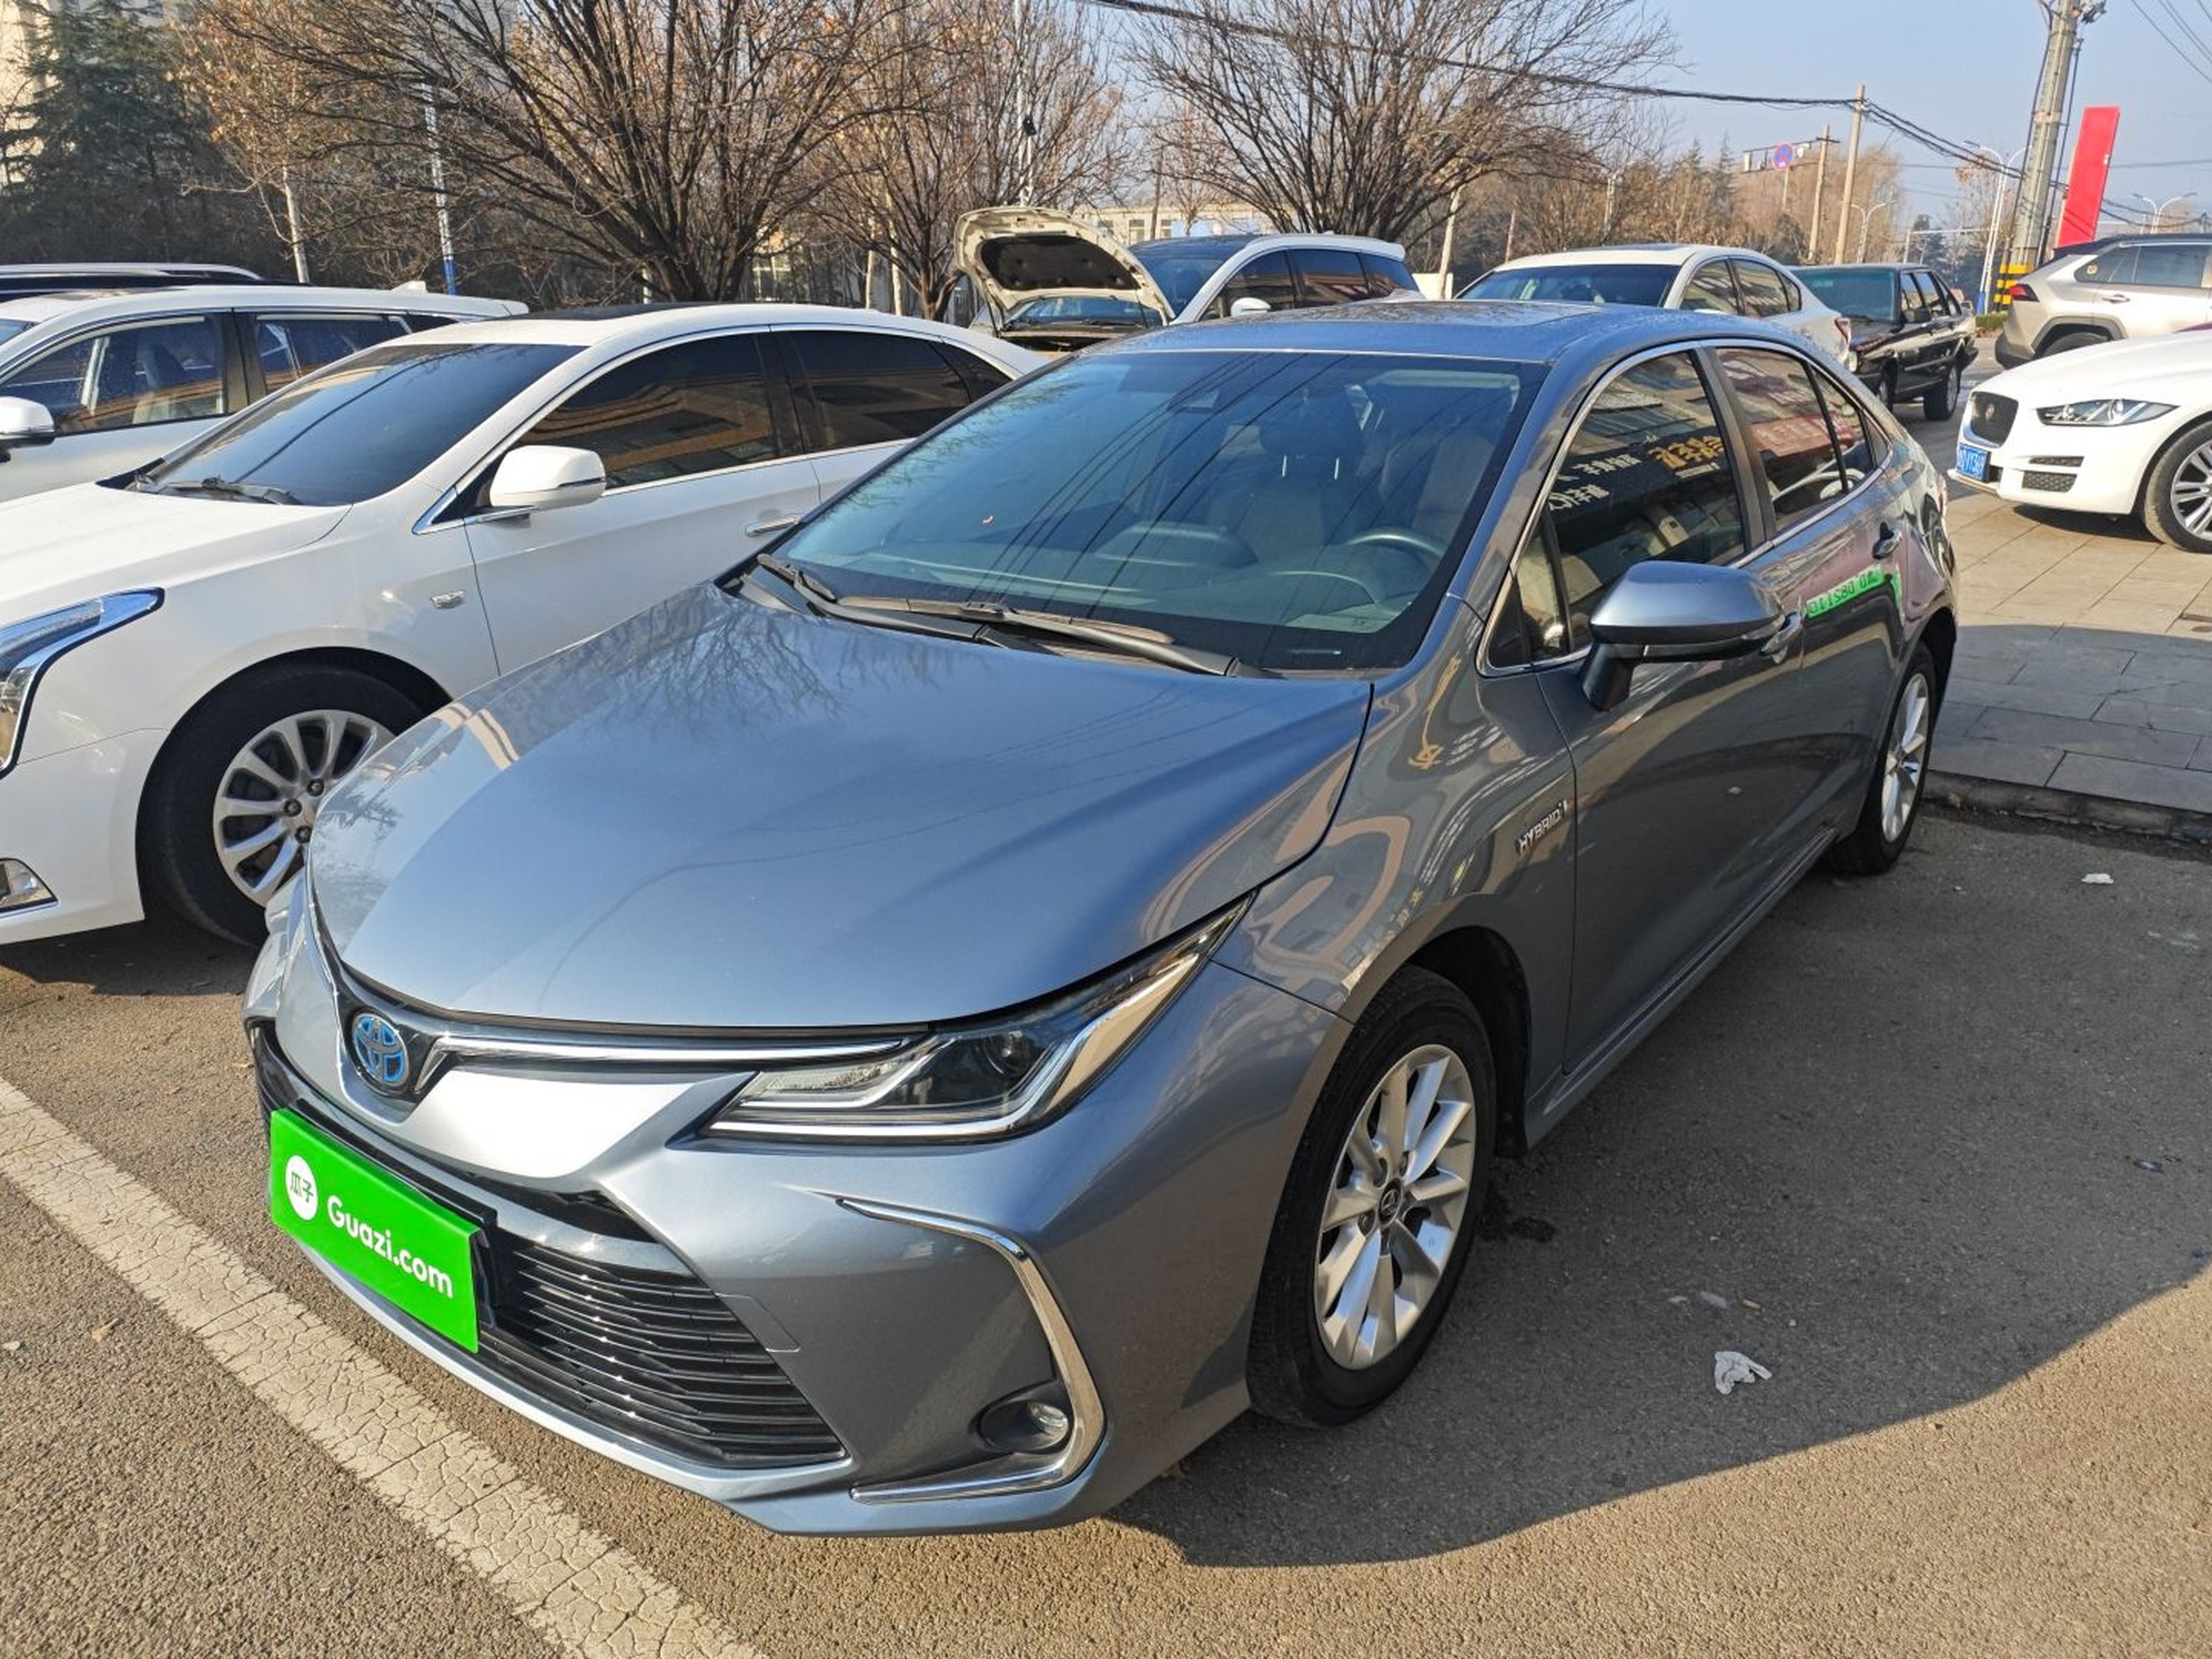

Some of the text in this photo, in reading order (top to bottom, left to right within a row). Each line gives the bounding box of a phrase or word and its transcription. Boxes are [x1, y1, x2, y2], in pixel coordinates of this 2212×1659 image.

[1517, 808, 1562, 854] HYBRID
[290, 1171, 314, 1203] 瓜子
[327, 1195, 453, 1298] Guazi.com
